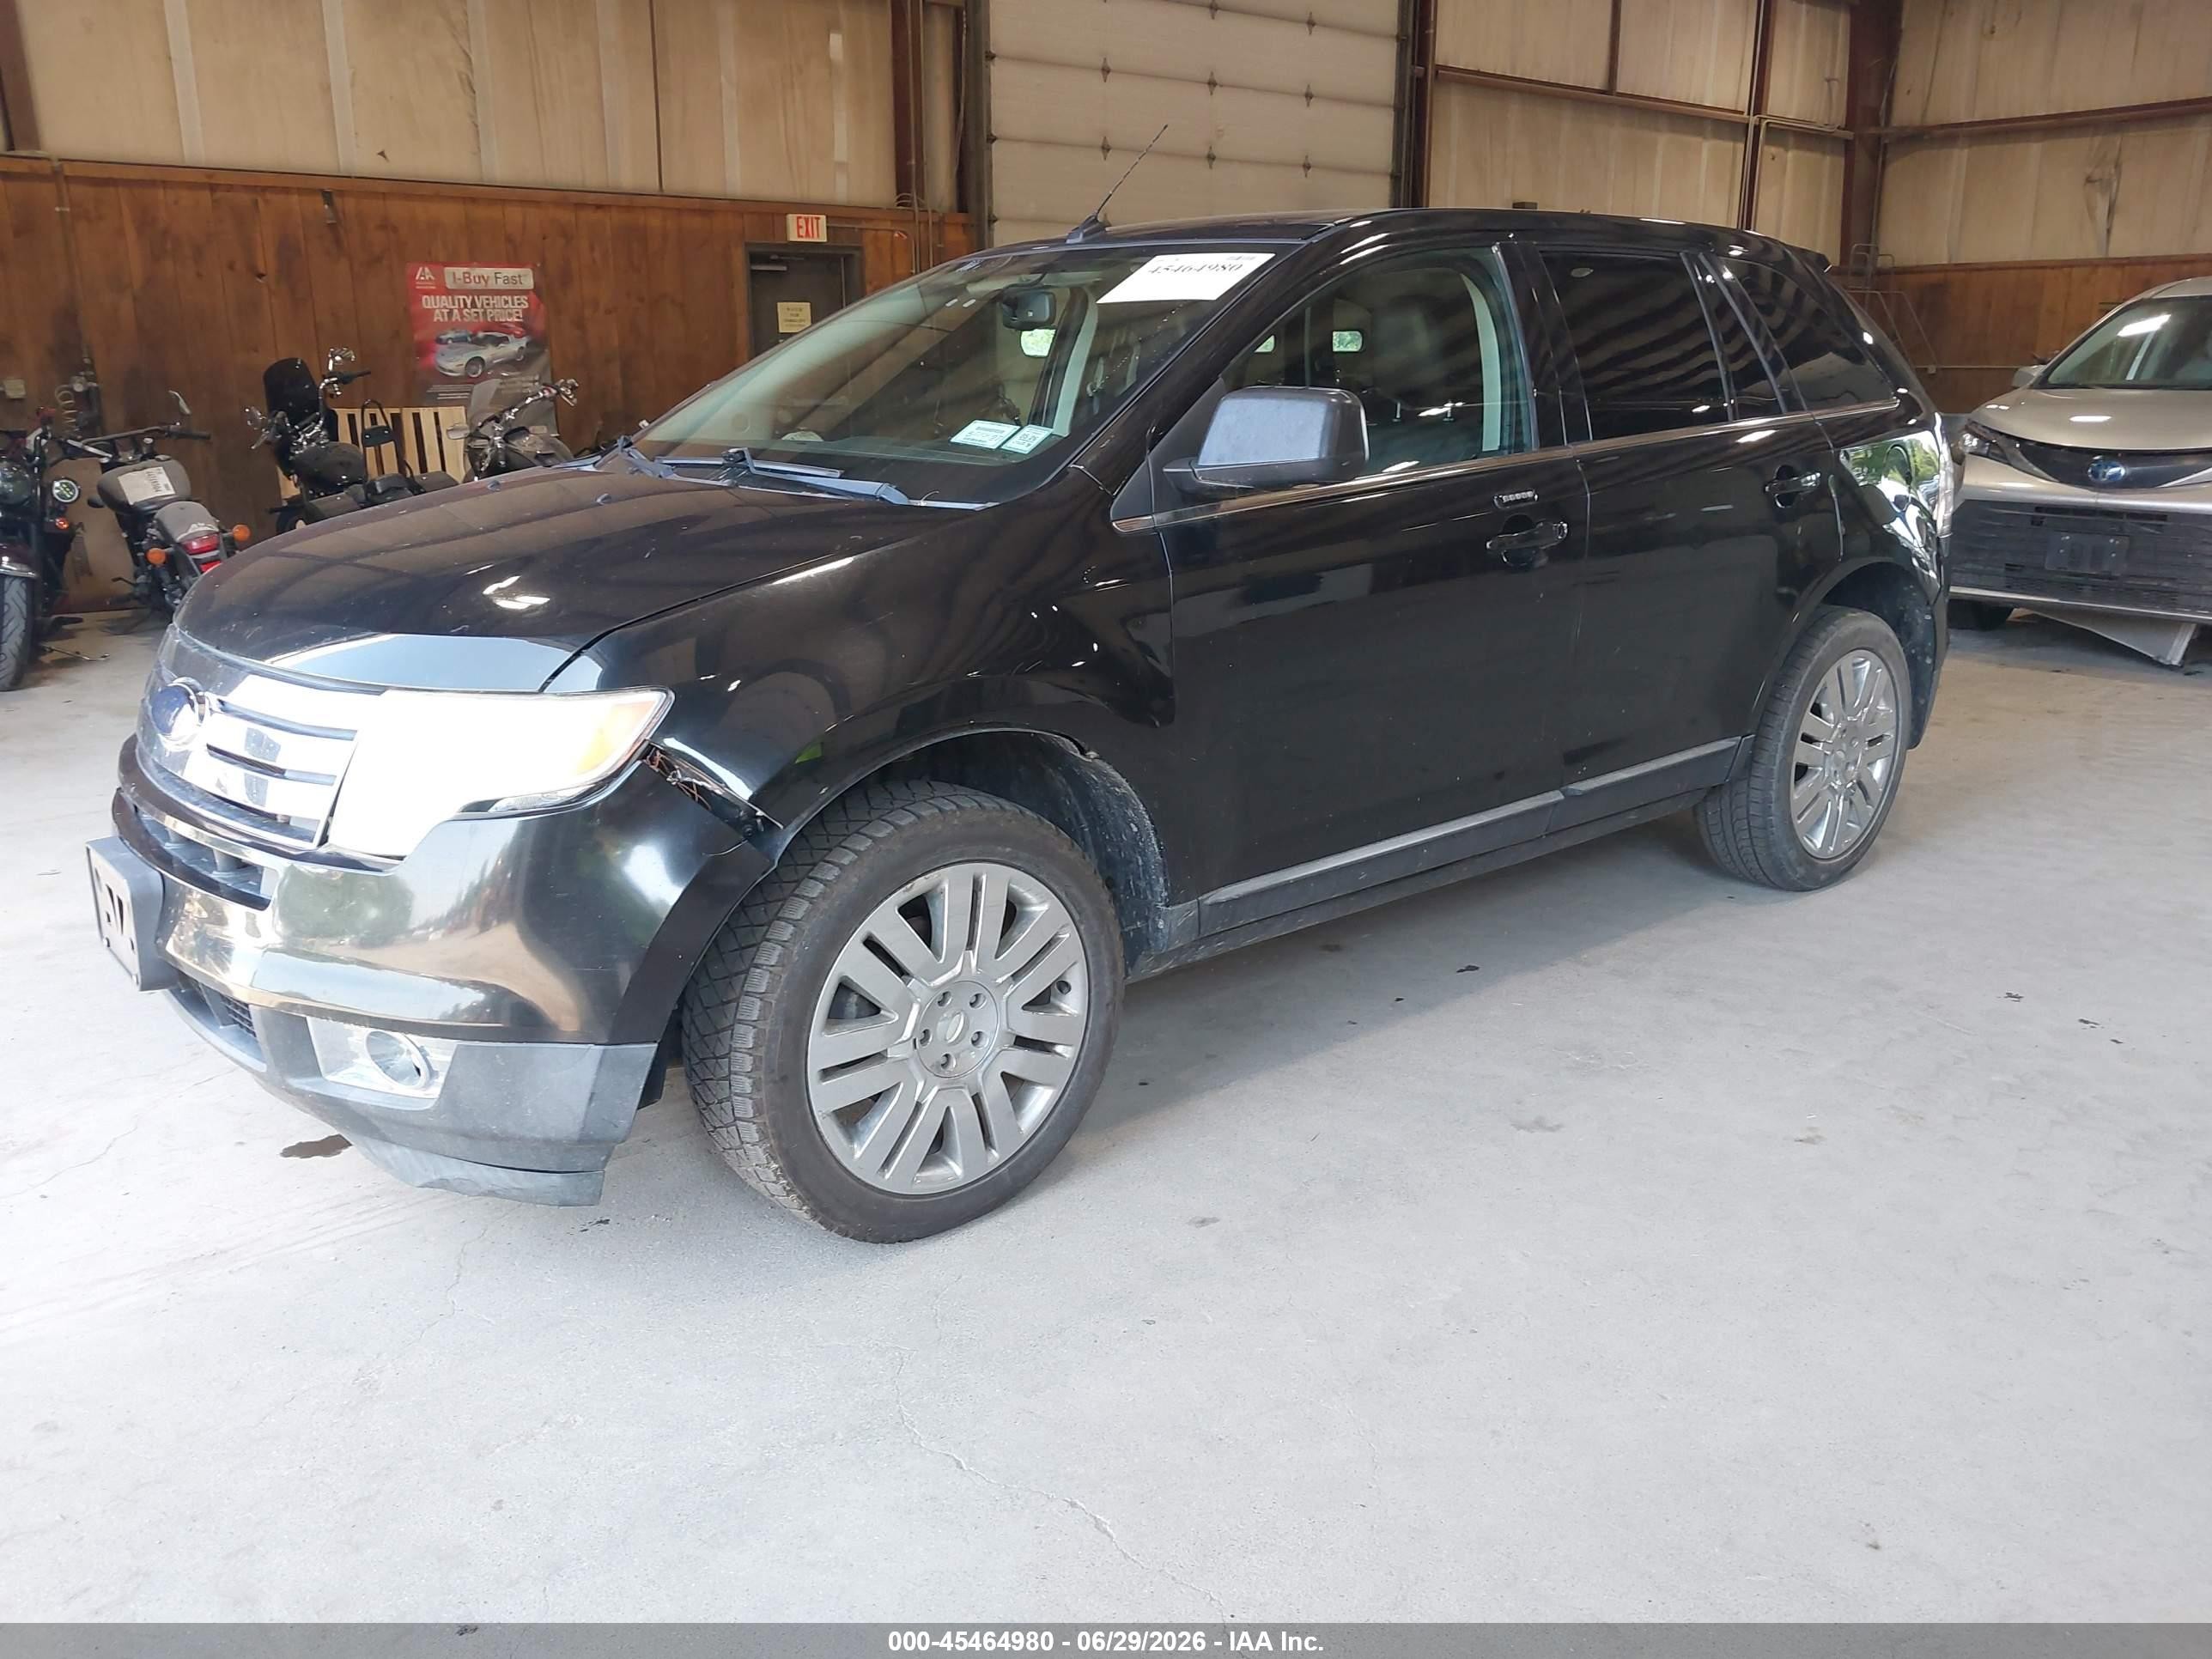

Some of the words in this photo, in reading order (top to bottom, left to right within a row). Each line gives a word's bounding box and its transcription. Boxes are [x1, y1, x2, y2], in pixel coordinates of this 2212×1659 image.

[797, 216, 820, 238] EXIT
[453, 271, 490, 287] I-Buy
[494, 271, 524, 285] Fast
[422, 295, 472, 309] QUALITY
[474, 295, 529, 309] VEHICLES
[434, 309, 450, 322] AT
[452, 309, 461, 322] A
[463, 309, 485, 322] SET
[487, 308, 523, 321] PRICE!
